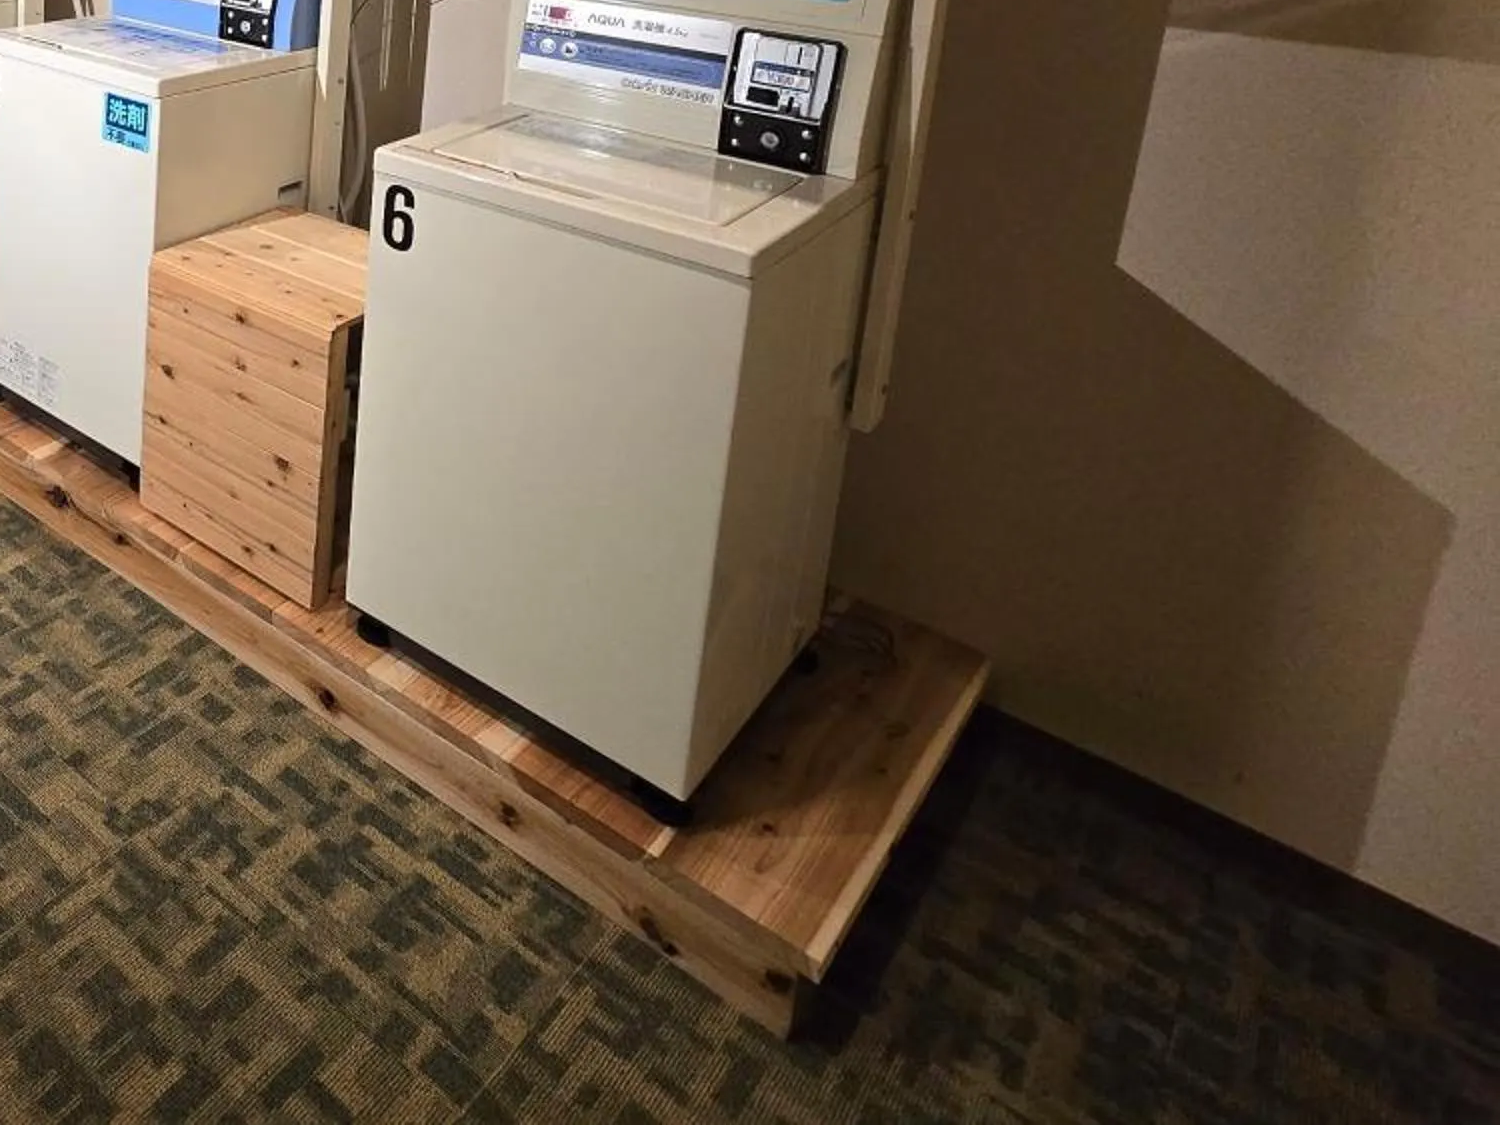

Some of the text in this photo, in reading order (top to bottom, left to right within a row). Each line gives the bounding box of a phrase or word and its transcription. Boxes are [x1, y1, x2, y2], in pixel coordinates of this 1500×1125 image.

[587, 13, 625, 28] AQUA
[109, 98, 145, 131] 洗剤
[383, 185, 415, 251] 6
